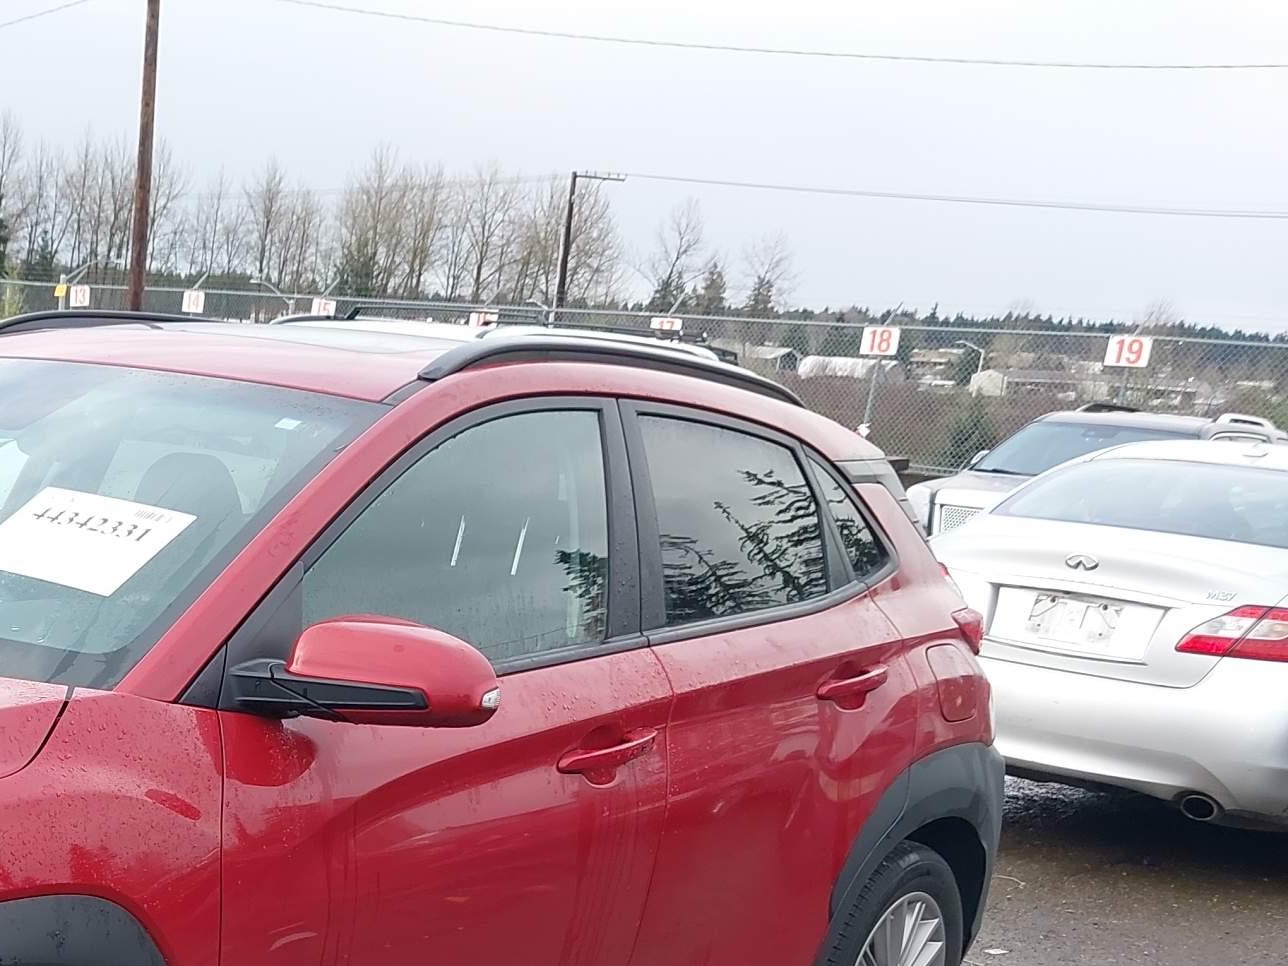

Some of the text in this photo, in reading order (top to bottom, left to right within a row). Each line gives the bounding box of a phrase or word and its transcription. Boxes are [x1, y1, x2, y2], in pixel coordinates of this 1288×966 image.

[75, 287, 87, 305] 13
[187, 293, 201, 311] 14
[869, 329, 893, 353] 18
[1115, 338, 1144, 365] 19
[32, 508, 153, 542] 44342331
